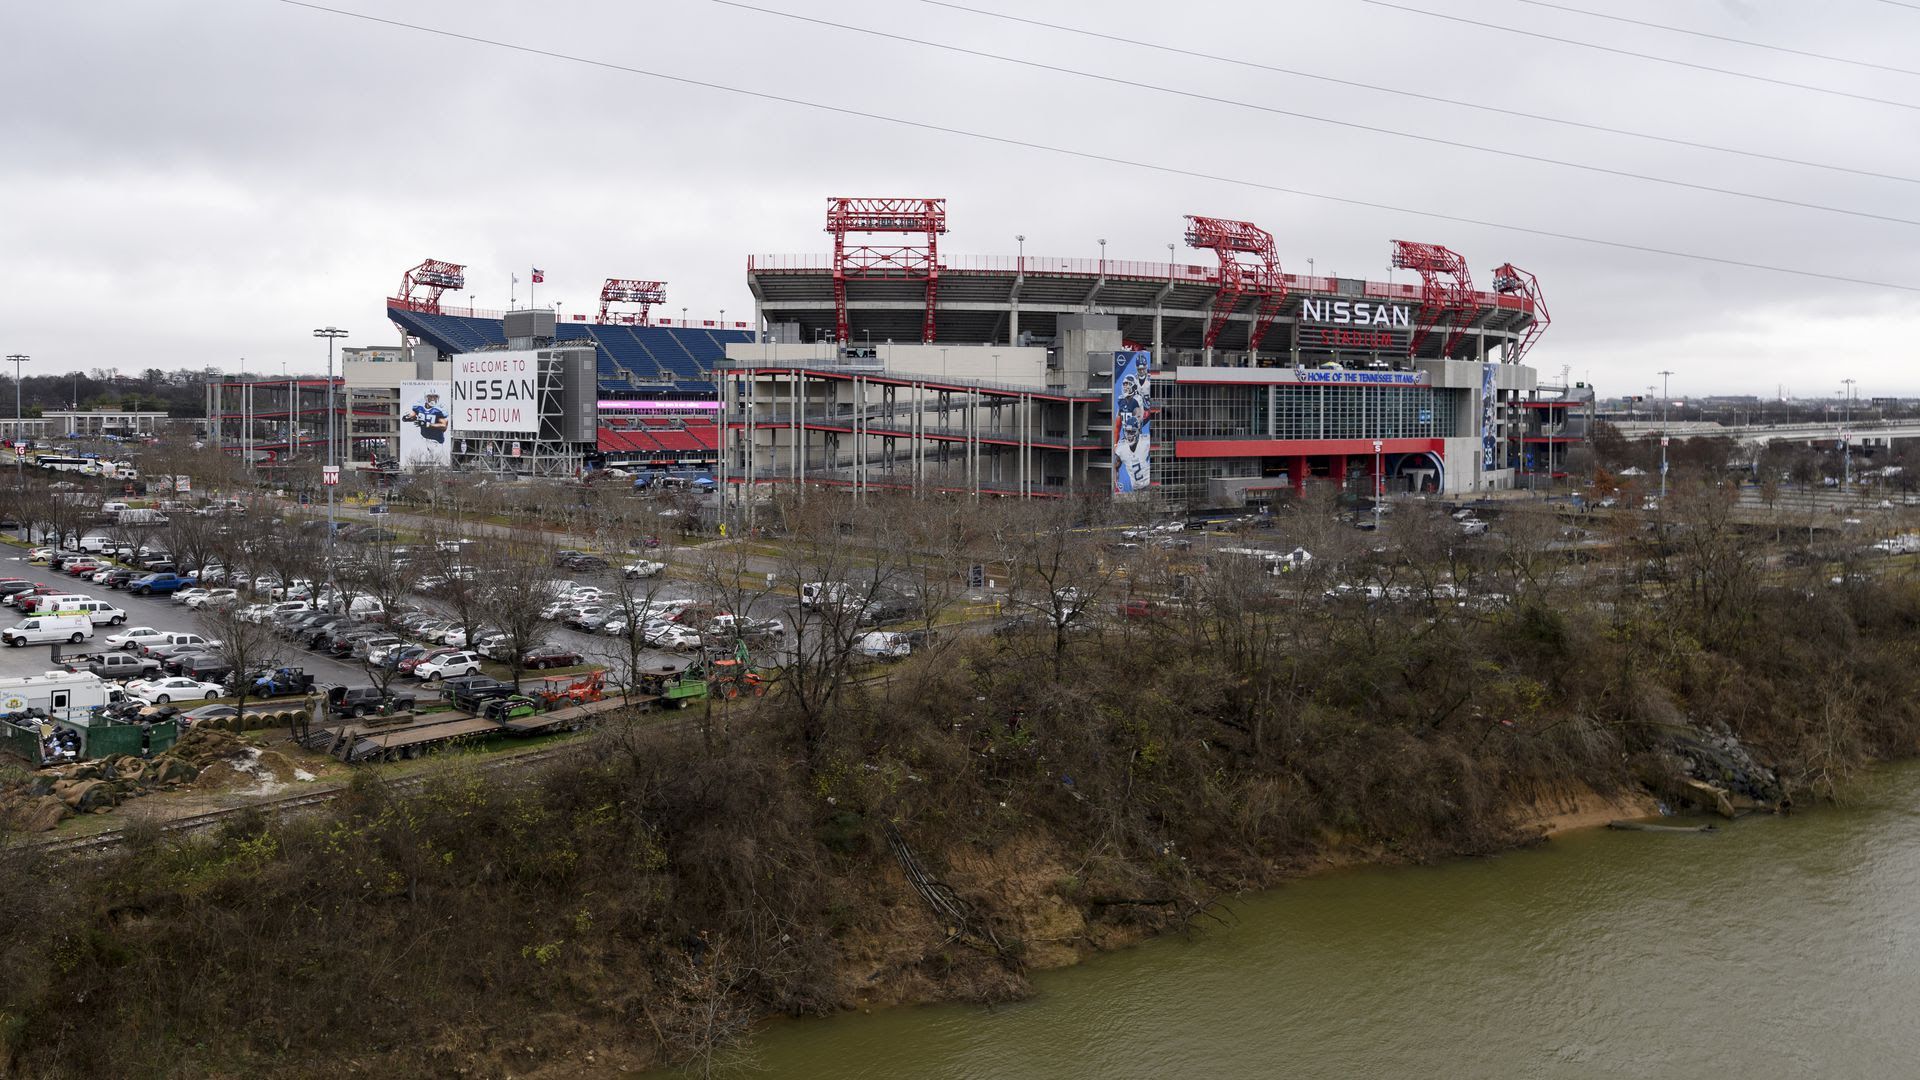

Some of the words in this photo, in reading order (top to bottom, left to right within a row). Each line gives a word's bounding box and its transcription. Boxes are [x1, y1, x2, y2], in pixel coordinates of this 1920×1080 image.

[1303, 299, 1409, 327] NISSAN
[1321, 329, 1393, 349] STADIUM
[462, 360, 508, 373] WELCOME
[512, 359, 526, 372] TO
[1307, 372, 1330, 382] HOME
[1332, 372, 1342, 382] OF
[1344, 373, 1357, 382] THE
[1358, 373, 1393, 383] TENNESSEE
[1394, 374, 1414, 384] TITANS
[454, 379, 535, 400] NISSAN
[466, 407, 521, 423] STADIUM
[323, 472, 339, 484] MM
[1132, 463, 1144, 480] 2
